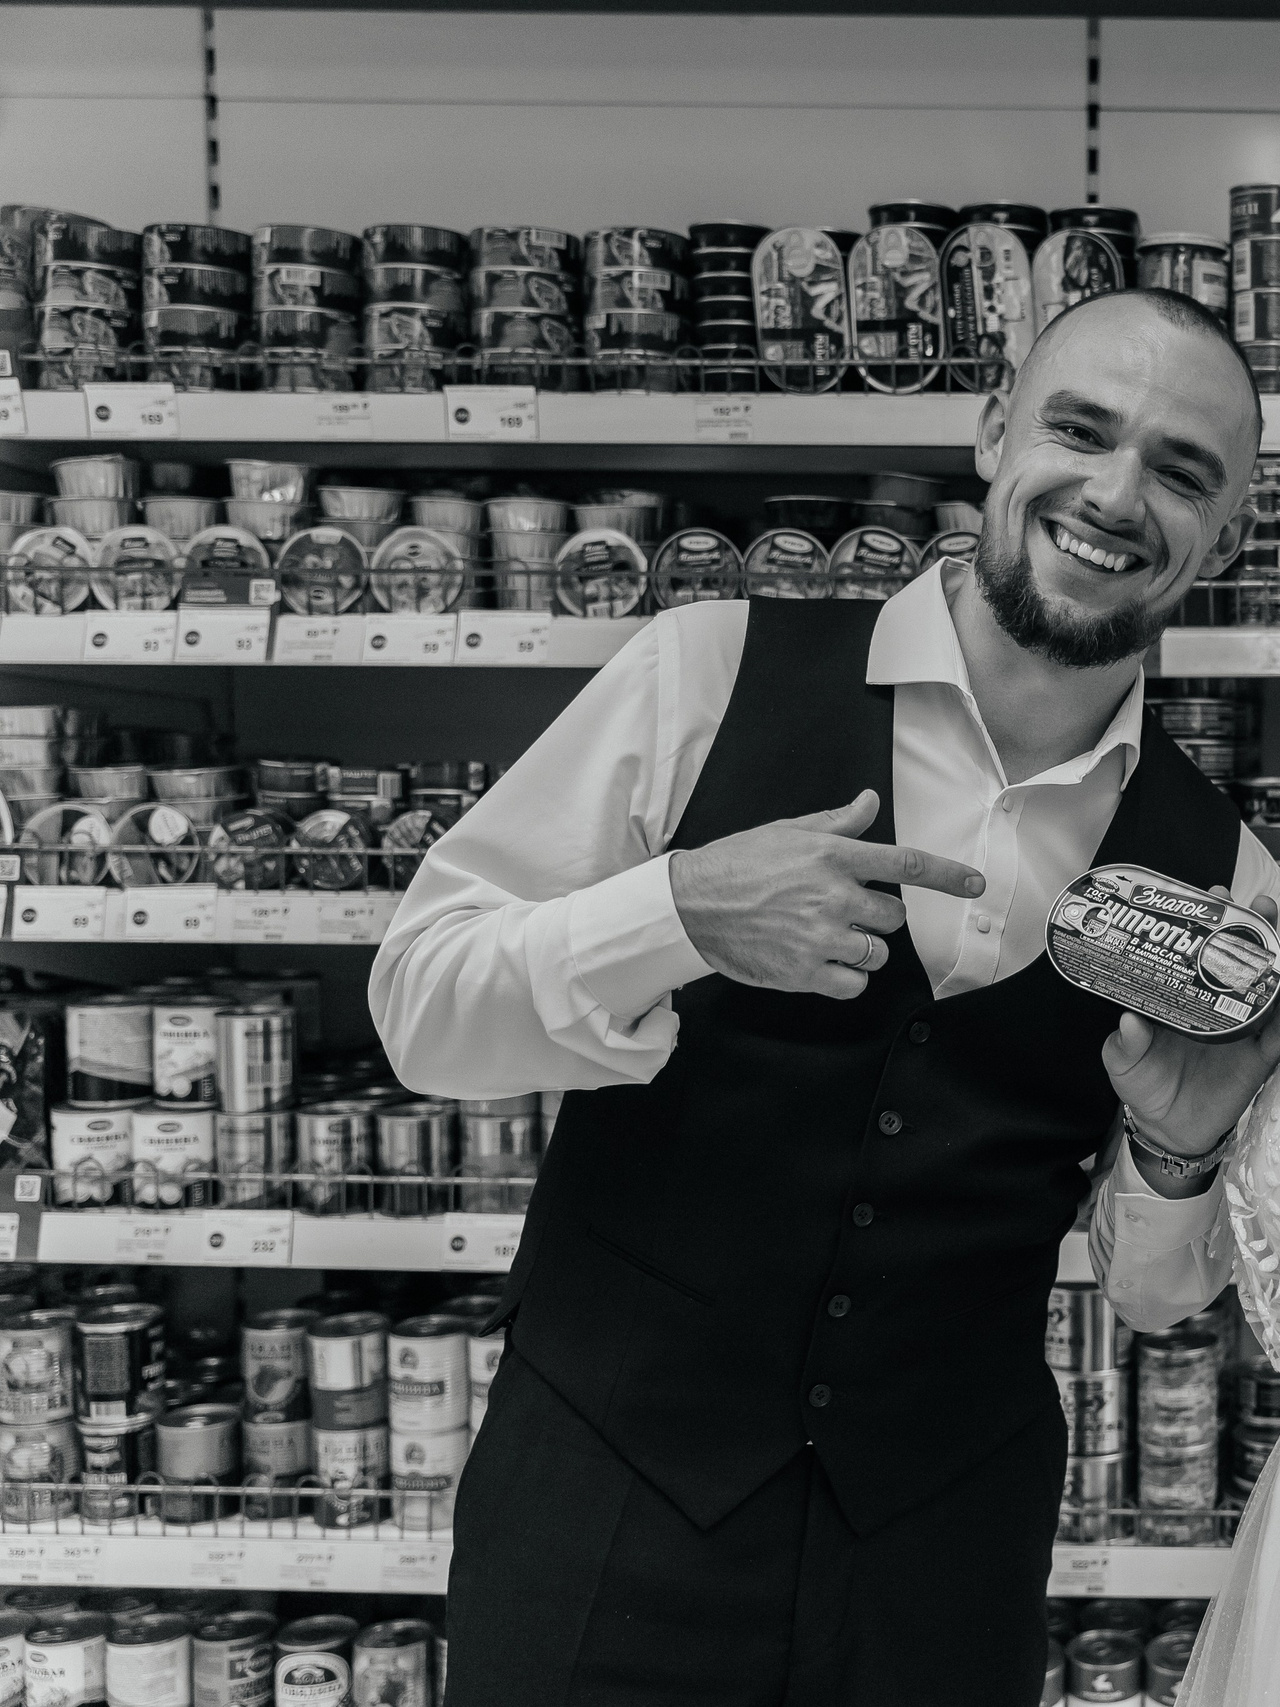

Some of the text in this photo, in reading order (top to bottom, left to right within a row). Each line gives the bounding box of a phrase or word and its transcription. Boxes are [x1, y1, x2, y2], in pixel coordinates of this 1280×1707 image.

[1085, 886, 1110, 900] ГОСТ
[1133, 885, 1211, 921] Знаток
[1130, 936, 1182, 963] в масле
[1125, 944, 1196, 977] ИЗ БАЛТИЙСКОЙ КИЛЬКИ
[1166, 976, 1180, 991] 175
[1197, 989, 1212, 1004] 123
